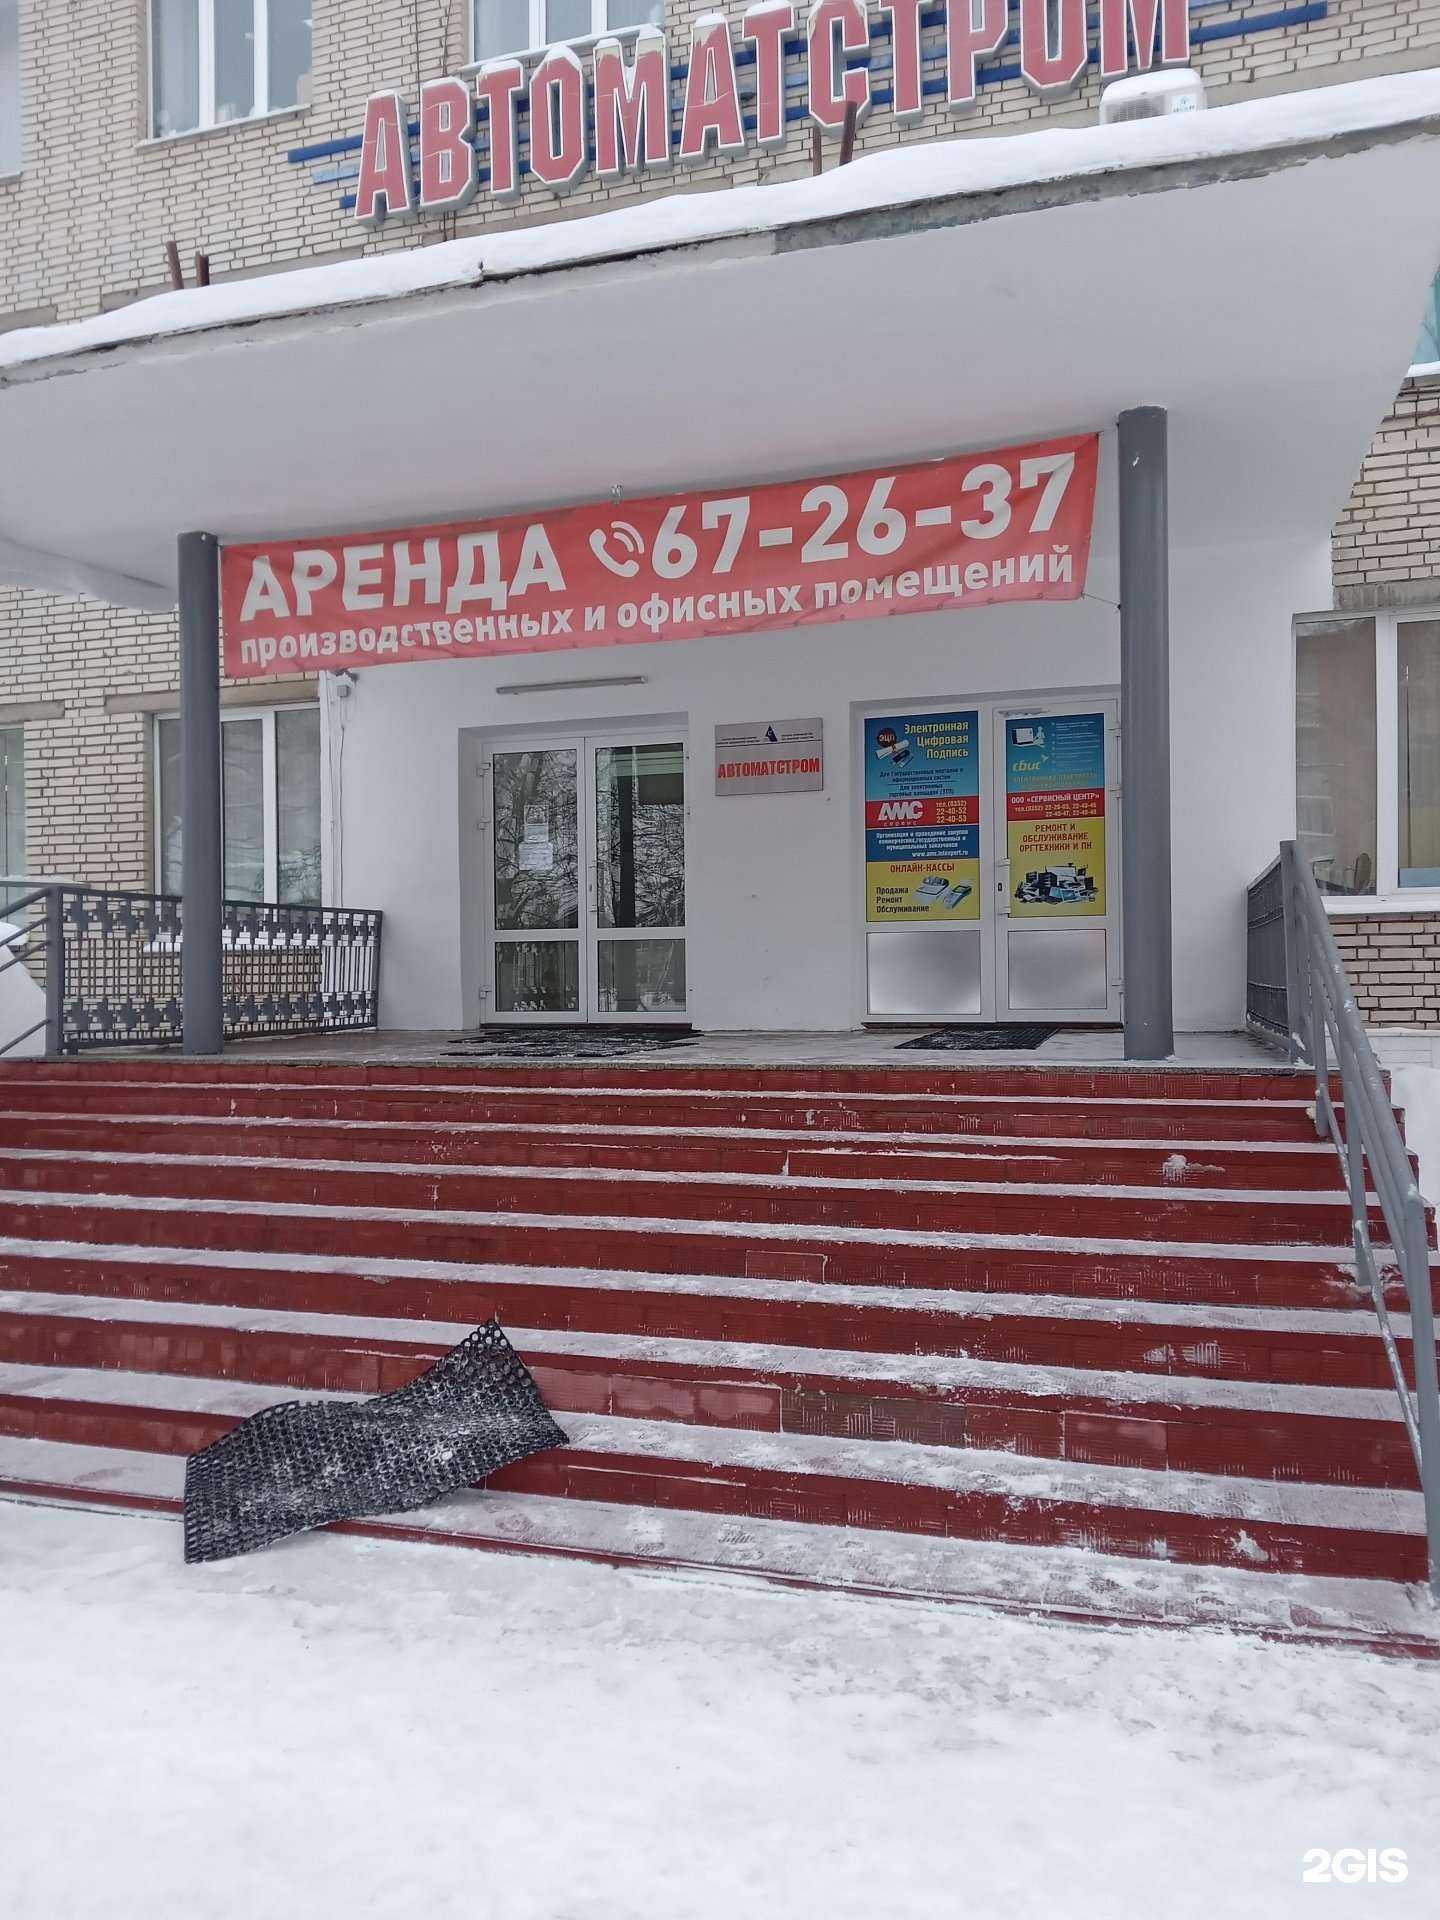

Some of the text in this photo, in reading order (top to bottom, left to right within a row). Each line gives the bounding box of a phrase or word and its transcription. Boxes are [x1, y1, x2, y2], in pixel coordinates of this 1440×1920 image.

[355, 0, 1191, 221] АВТОМАТСТРОМ
[240, 452, 1076, 621] АРЕНДА 67-26-37
[241, 545, 1073, 667] производственных и офисных помещений
[905, 722, 968, 733] Электронная
[917, 735, 969, 748] Цифровая
[927, 749, 968, 759] Подпись
[718, 758, 820, 778] АВТОМАТСТРОМ
[1034, 823, 1067, 833] РЕМОНТ
[1022, 831, 1089, 843] ОБСЛУЖИВАНИЕ
[1019, 843, 1069, 852] ОРГТЕХНИКИ
[1072, 842, 1078, 850] И
[876, 886, 909, 895] Продажа
[876, 896, 903, 904] Ремонт
[877, 906, 929, 914] Обслуживание
